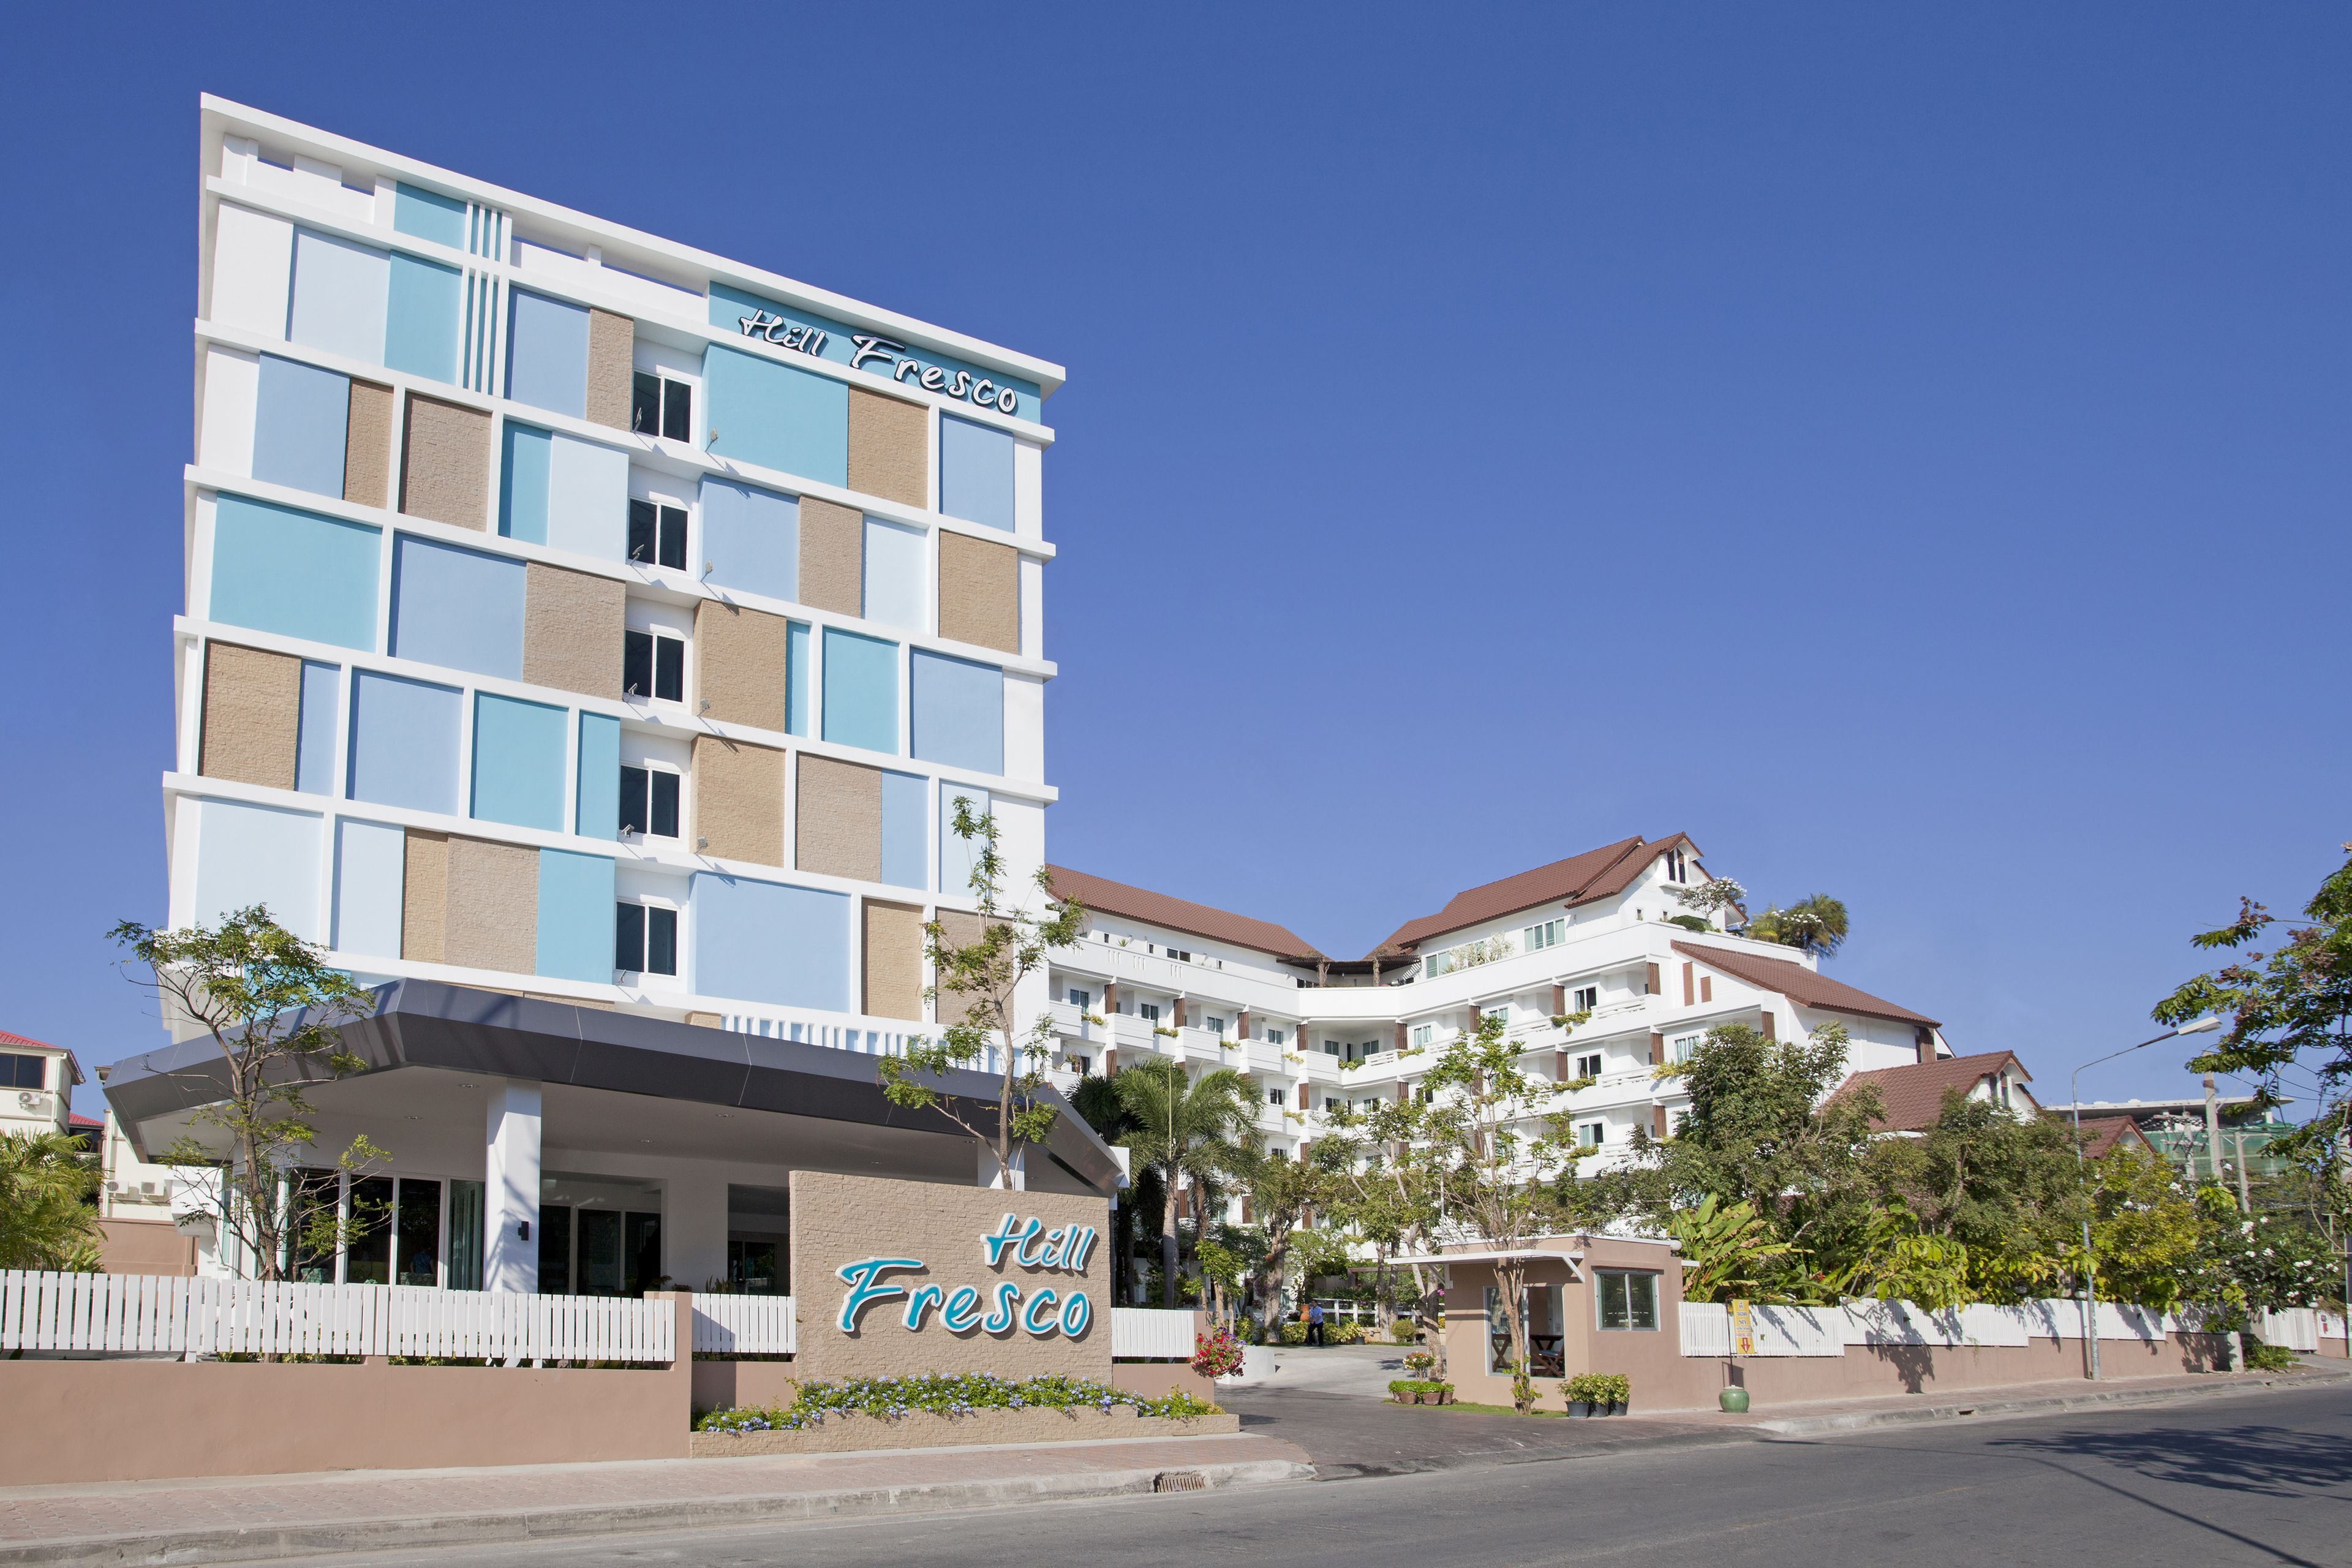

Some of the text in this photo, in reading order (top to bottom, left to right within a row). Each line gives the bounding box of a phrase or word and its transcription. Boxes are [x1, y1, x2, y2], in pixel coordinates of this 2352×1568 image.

[738, 308, 1018, 415] Hill Fresco
[980, 1212, 1096, 1272] Hill
[835, 1256, 1090, 1337] Fresco
